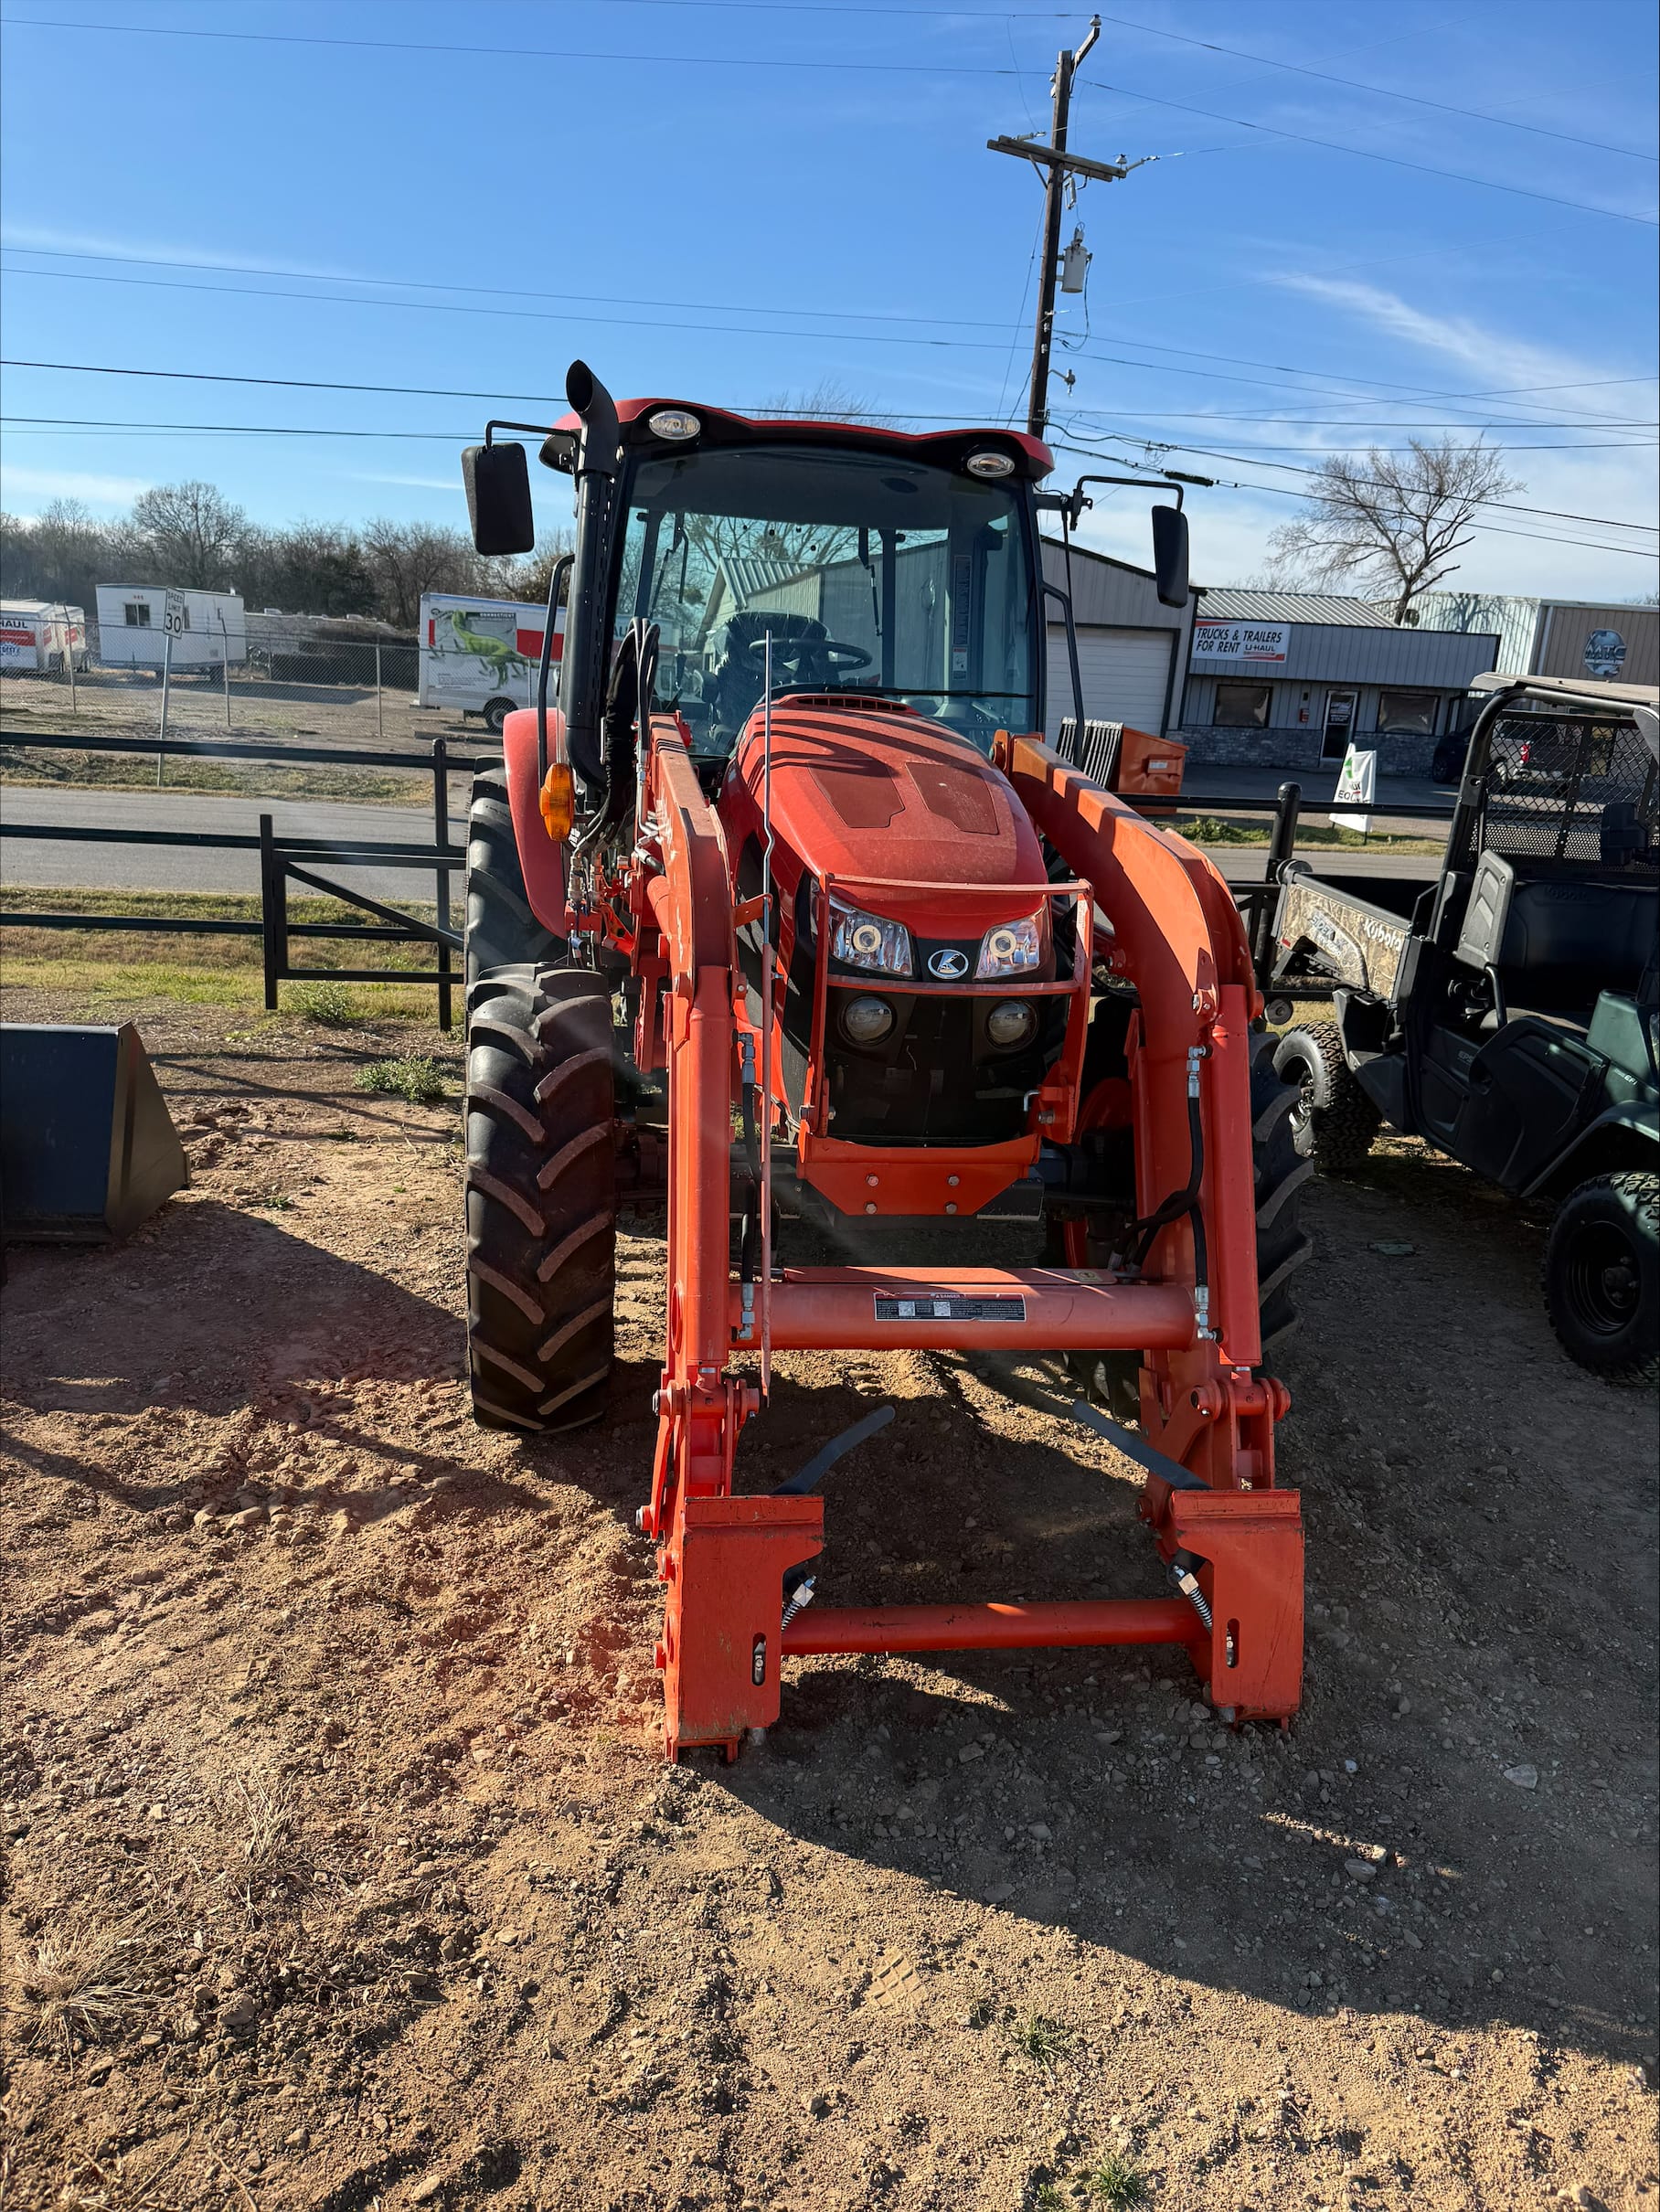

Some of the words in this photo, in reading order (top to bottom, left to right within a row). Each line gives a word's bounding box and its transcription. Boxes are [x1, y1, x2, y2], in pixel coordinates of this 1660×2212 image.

[167, 591, 183, 603] SPEED
[168, 603, 181, 611] LIMIT
[165, 613, 182, 633] 30
[1197, 628, 1229, 640] TRUCKS
[1232, 629, 1240, 641] &
[1242, 631, 1282, 643] TRAILERS
[1196, 640, 1214, 652] FOR
[1217, 641, 1241, 653] RENT
[1364, 918, 1402, 952] Kubota
